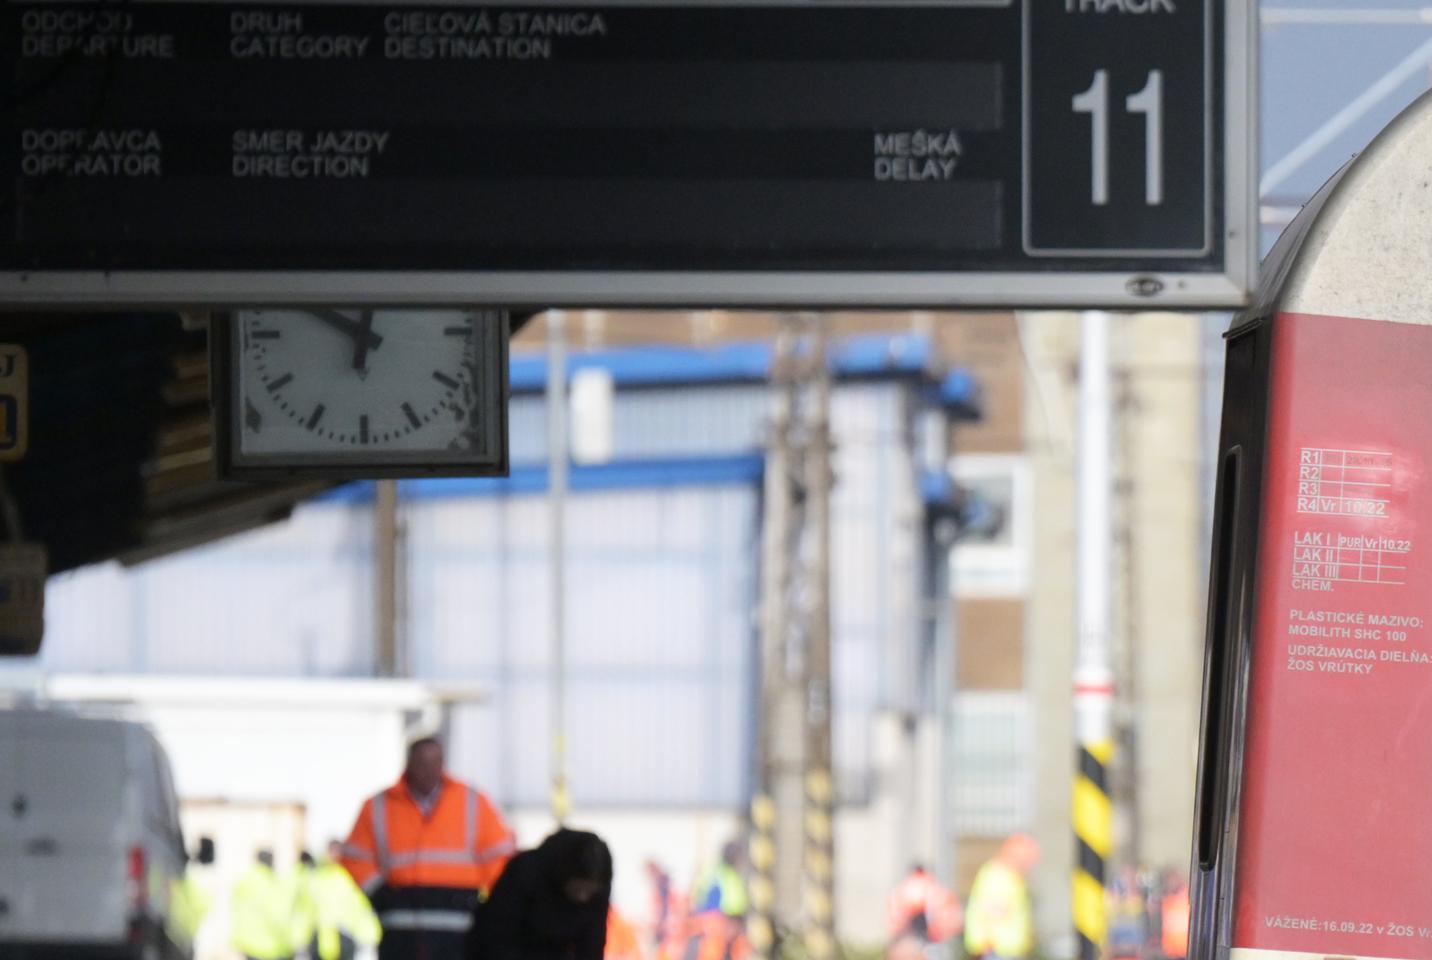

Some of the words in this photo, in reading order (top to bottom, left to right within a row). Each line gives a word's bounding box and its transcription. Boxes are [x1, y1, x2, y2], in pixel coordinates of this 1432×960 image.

[231, 12, 302, 34] DRUH
[499, 13, 606, 35] STANICA
[231, 35, 368, 58] CATEGORY
[385, 36, 551, 59] DESTINATION
[234, 131, 302, 152] SMER
[311, 131, 388, 154] JAZDY
[1073, 70, 1162, 205] 11
[233, 153, 368, 177] DIRECTION
[875, 156, 955, 180] DELAY
[1301, 450, 1319, 464] R1
[1300, 466, 1318, 480] R2
[1299, 481, 1317, 496] R3
[1298, 497, 1316, 512] R4
[1294, 531, 1322, 546] LAK
[1339, 537, 1361, 548] PUR
[1365, 537, 1377, 549] Vr
[1382, 541, 1410, 552] 10.22
[1294, 547, 1321, 561] LAK
[1326, 550, 1333, 562] II
[1293, 564, 1319, 577] LAK
[1325, 565, 1337, 578] III
[1290, 610, 1364, 625] PLASTICKÉ
[1288, 624, 1350, 638] MOBILITH
[1354, 628, 1381, 641] SHC
[1386, 630, 1407, 642] 100
